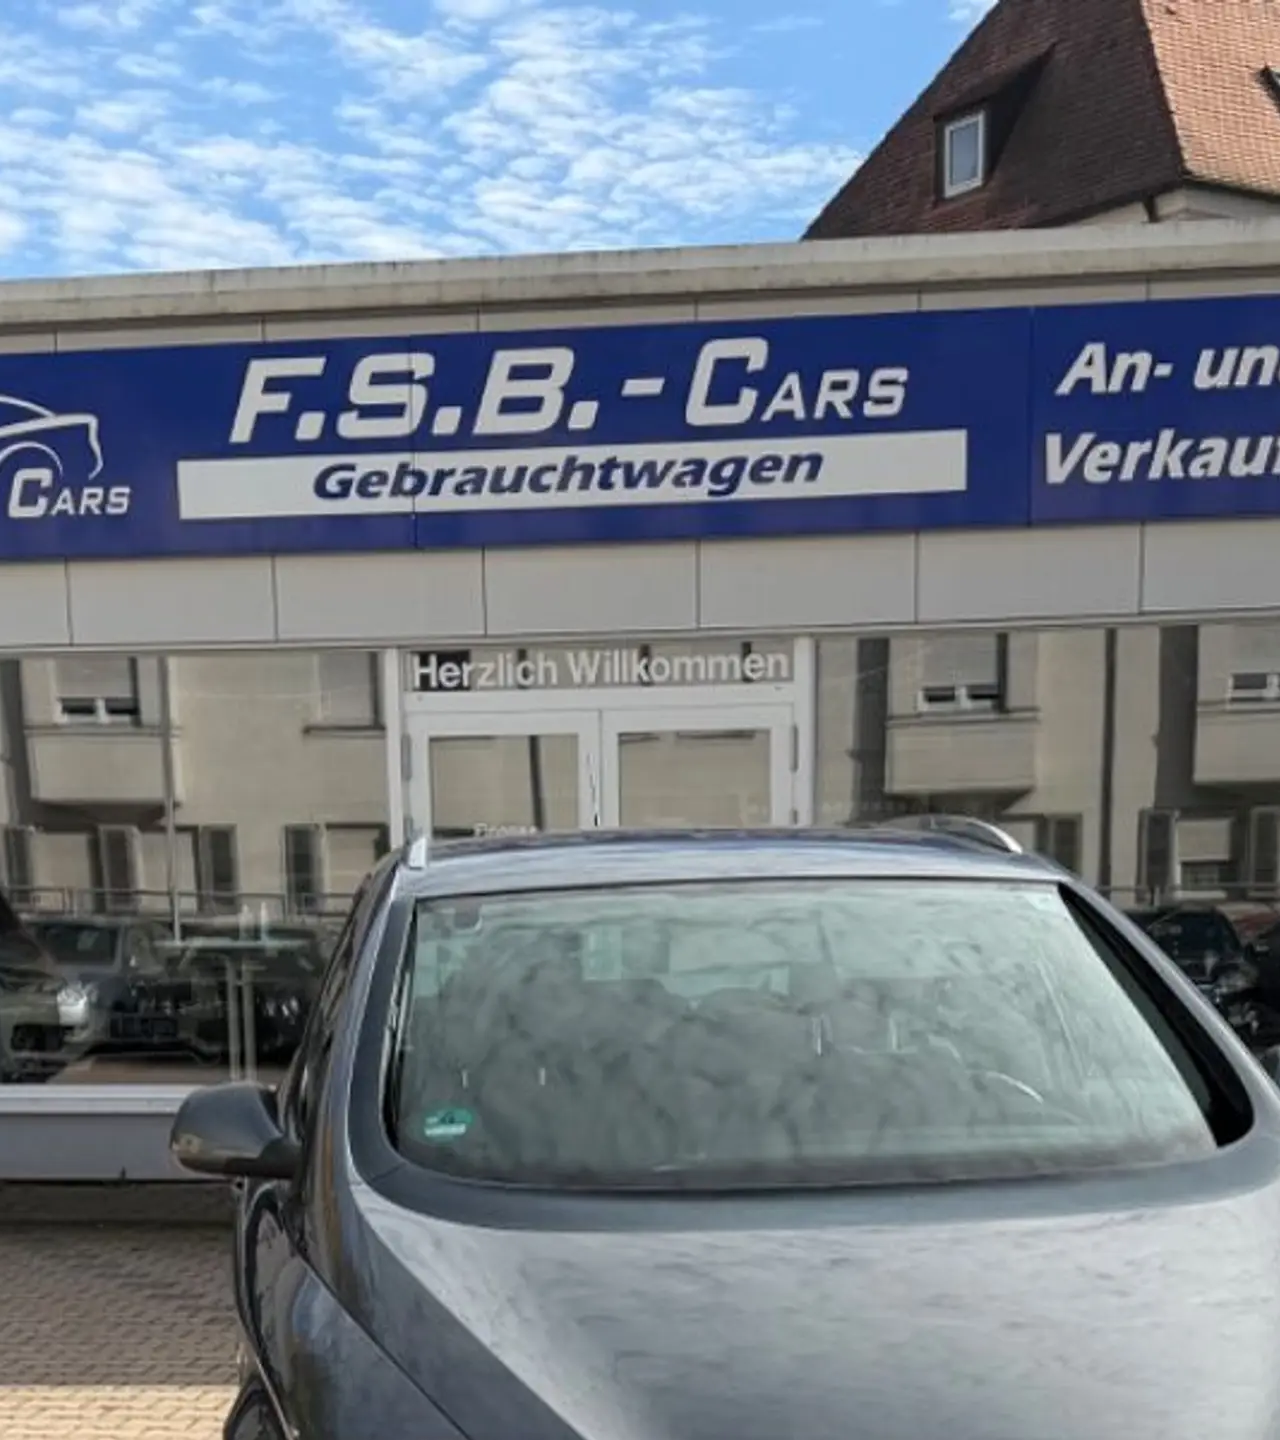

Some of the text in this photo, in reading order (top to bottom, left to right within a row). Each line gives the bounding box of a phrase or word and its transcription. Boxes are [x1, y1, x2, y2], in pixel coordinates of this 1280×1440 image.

[1055, 341, 1174, 396] An-
[312, 449, 825, 502] Gebrauchtwagen
[412, 646, 790, 689] Herzlich Willkommen
